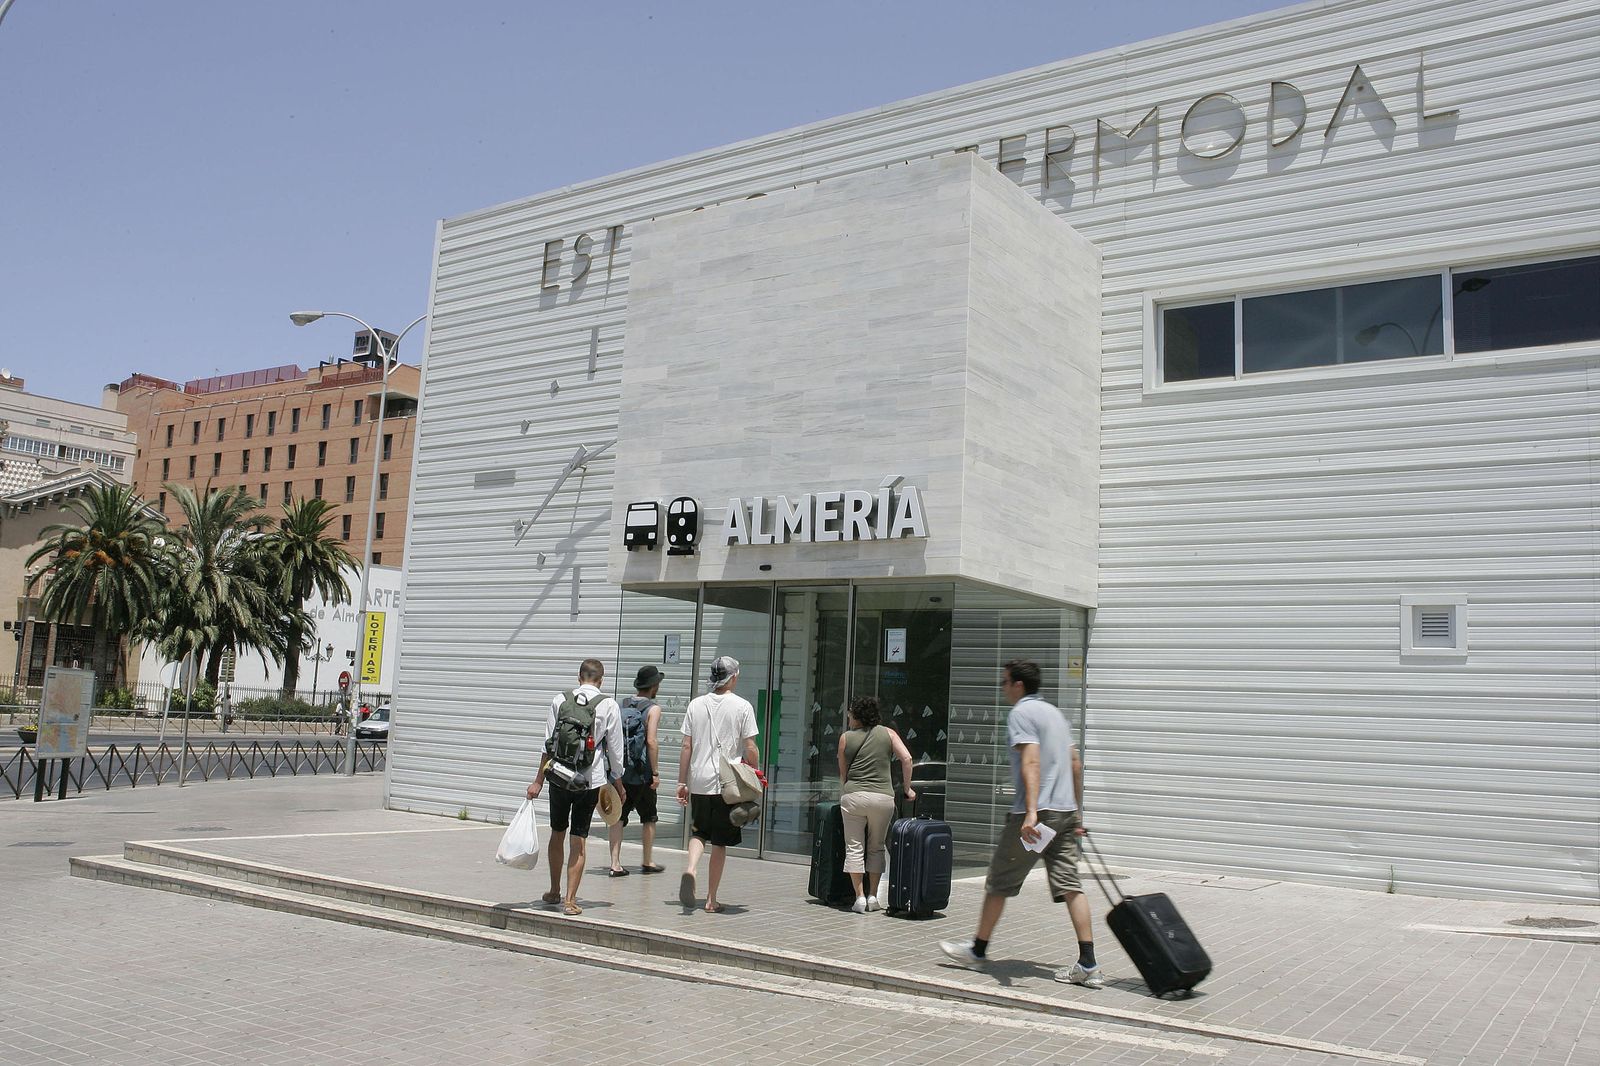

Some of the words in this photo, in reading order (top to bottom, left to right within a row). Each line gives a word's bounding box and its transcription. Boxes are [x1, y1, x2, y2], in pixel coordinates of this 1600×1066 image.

[954, 52, 1460, 190] ERMODAL
[724, 475, 929, 546] ALMERÍA
[367, 614, 379, 674] LOTERIAS
